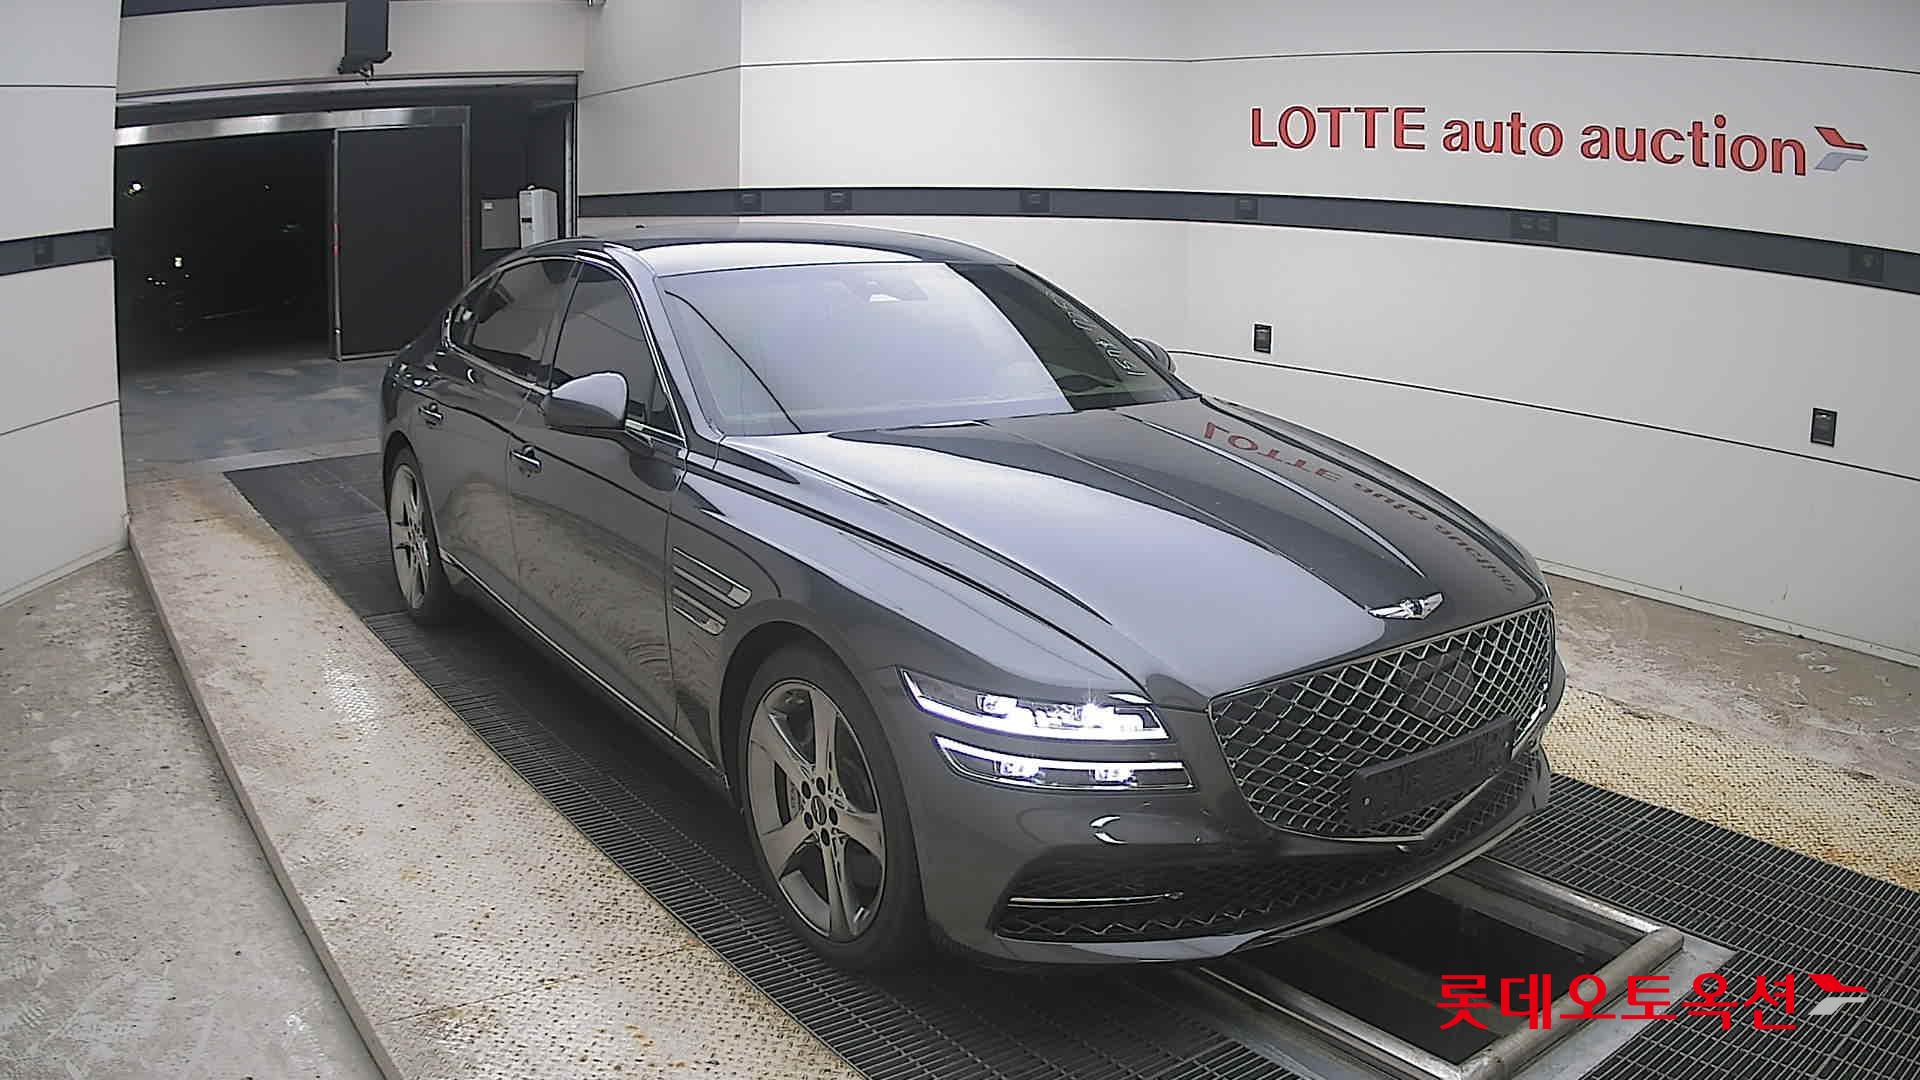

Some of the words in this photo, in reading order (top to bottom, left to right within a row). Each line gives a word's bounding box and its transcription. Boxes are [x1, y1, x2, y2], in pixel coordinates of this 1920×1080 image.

[1250, 105, 1426, 150] LOTTE
[1441, 112, 1564, 157] auto
[1578, 114, 1807, 177] auction
